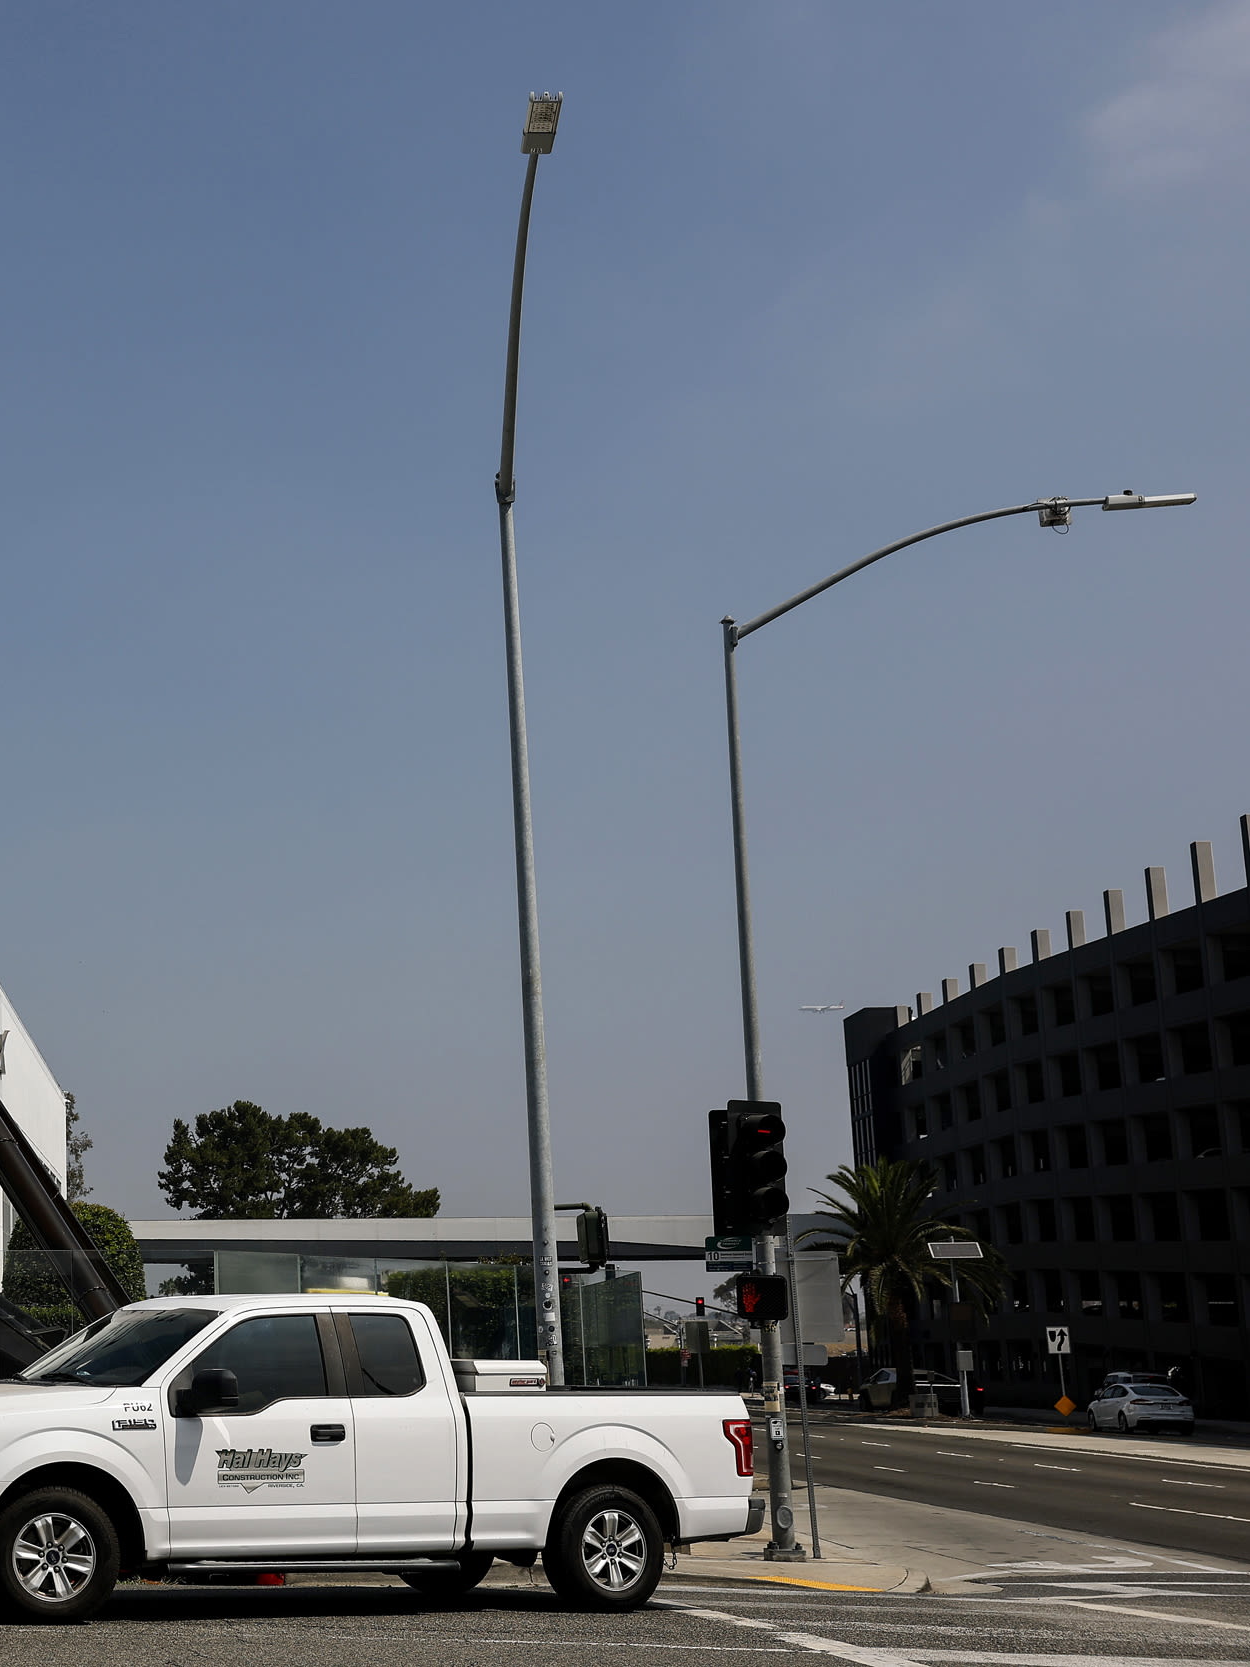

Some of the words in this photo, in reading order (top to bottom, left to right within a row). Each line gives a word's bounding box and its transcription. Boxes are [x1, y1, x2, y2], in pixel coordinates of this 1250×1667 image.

[708, 1252, 720, 1261] 10
[123, 1402, 153, 1412] PU62
[217, 1448, 253, 1470] Hal
[253, 1448, 303, 1473] Hays
[222, 1474, 284, 1482] CONSTRUCTION
